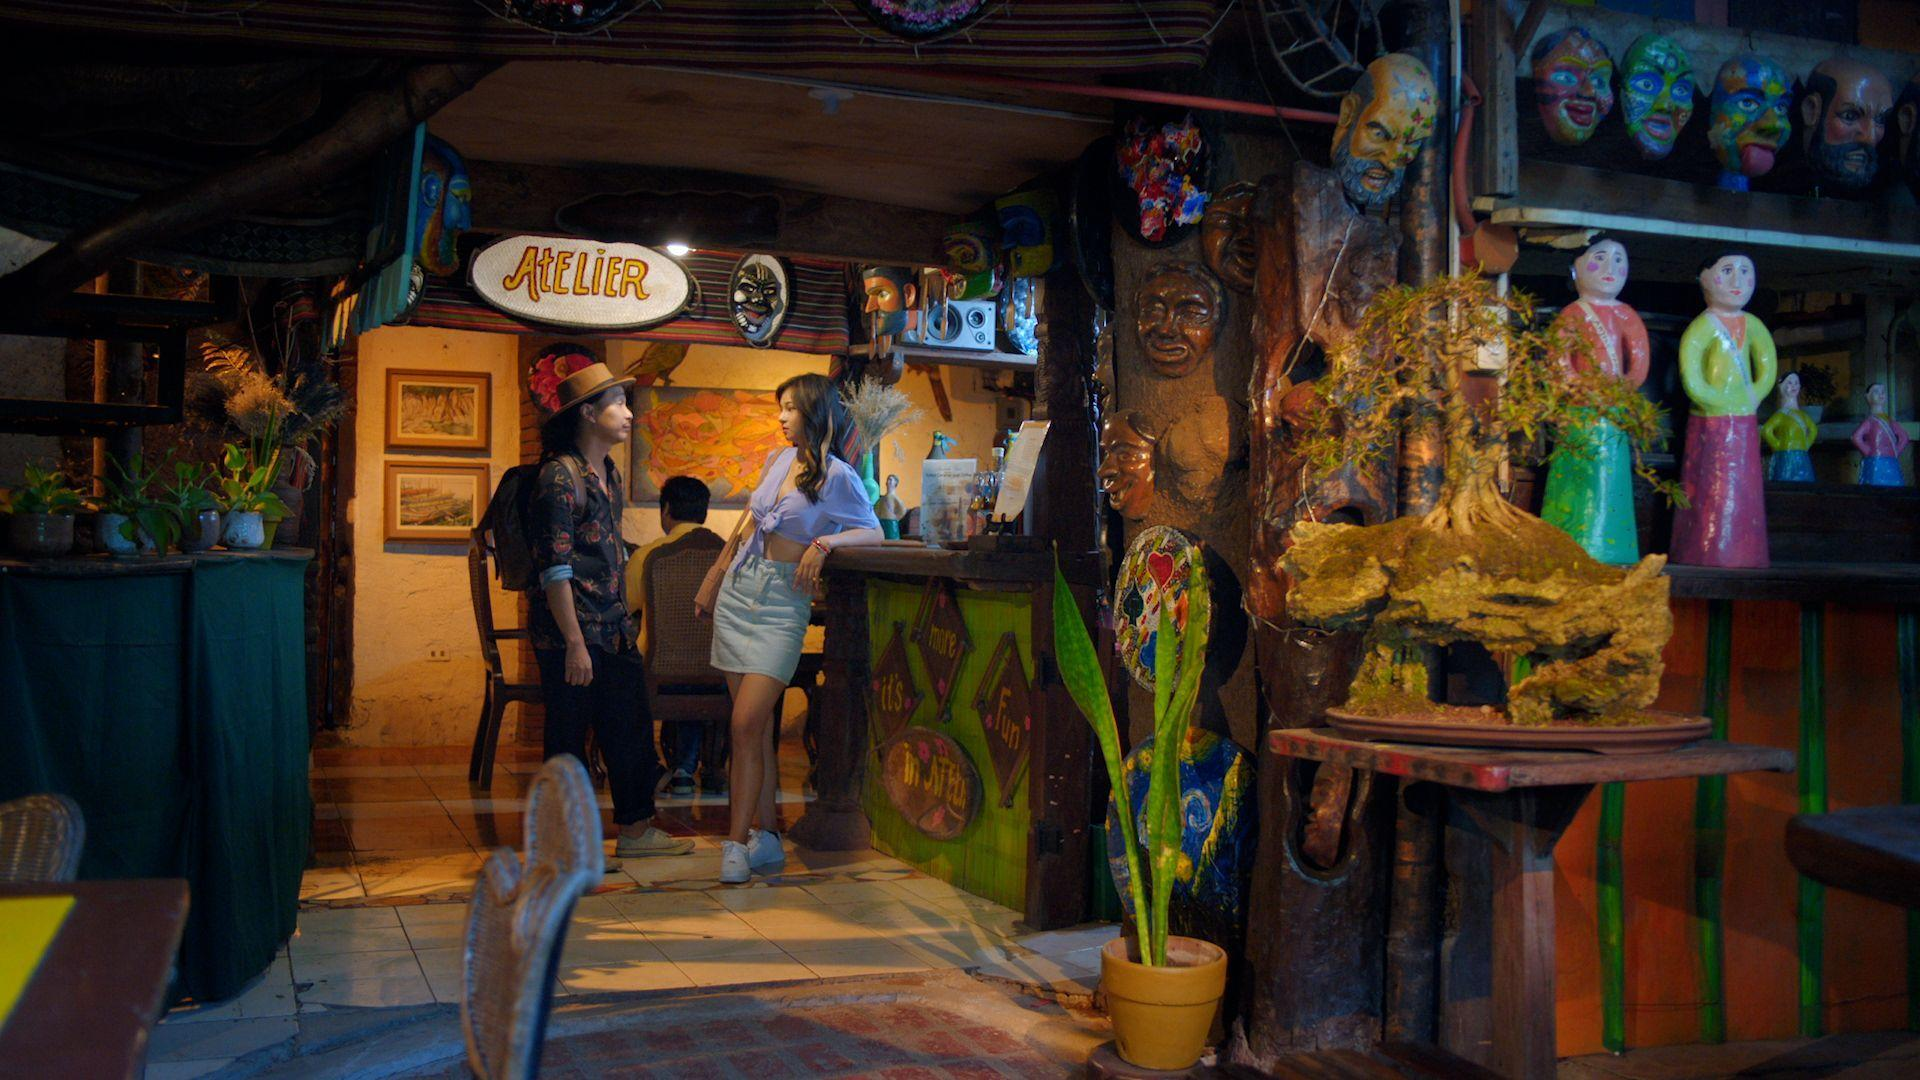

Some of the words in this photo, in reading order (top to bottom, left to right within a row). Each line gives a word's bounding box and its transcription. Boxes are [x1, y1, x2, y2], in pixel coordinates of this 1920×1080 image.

[928, 625, 958, 660] more
[995, 686, 1020, 750] Fun
[903, 741, 920, 789] in
